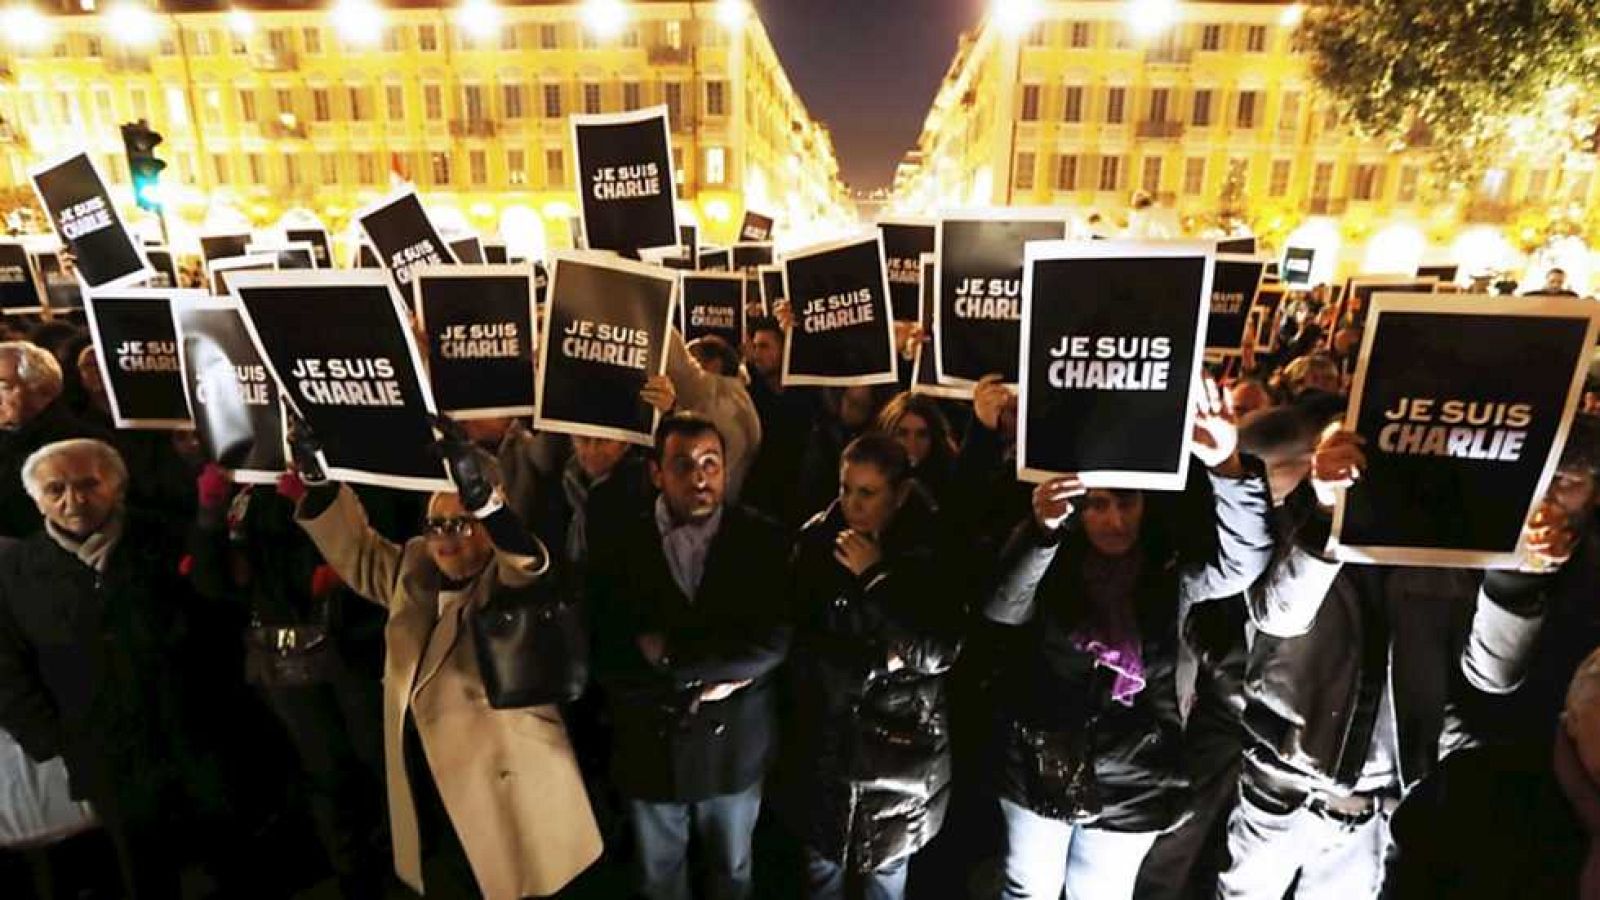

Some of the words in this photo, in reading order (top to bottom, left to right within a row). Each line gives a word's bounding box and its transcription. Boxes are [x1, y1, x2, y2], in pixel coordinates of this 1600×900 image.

[592, 167, 616, 182] JE
[618, 162, 658, 180] SUIS
[593, 177, 661, 200] CHARLIE
[955, 277, 985, 295] JE
[987, 278, 1020, 296] SU
[803, 298, 826, 315] JE
[828, 288, 872, 310] SUIS
[954, 297, 1022, 319] CHARL
[804, 303, 875, 333] CHARLIE
[439, 325, 467, 340] JE
[469, 322, 518, 339] SUIS
[563, 319, 594, 338] JE
[596, 323, 649, 346] SUIS
[116, 340, 145, 354] JE
[145, 340, 176, 354] SU
[439, 339, 521, 358] CHARLIE
[562, 337, 649, 370] CHARLIE
[1048, 335, 1090, 359] JE
[1095, 335, 1172, 359] SUIS
[291, 358, 326, 379] JE
[326, 357, 395, 379] SUIS
[1047, 359, 1171, 391] CHARLIE
[298, 378, 406, 406] CHARLIE
[1384, 397, 1434, 421] JE
[1438, 401, 1534, 427] SUIS
[1377, 422, 1528, 462] CHARLIE
